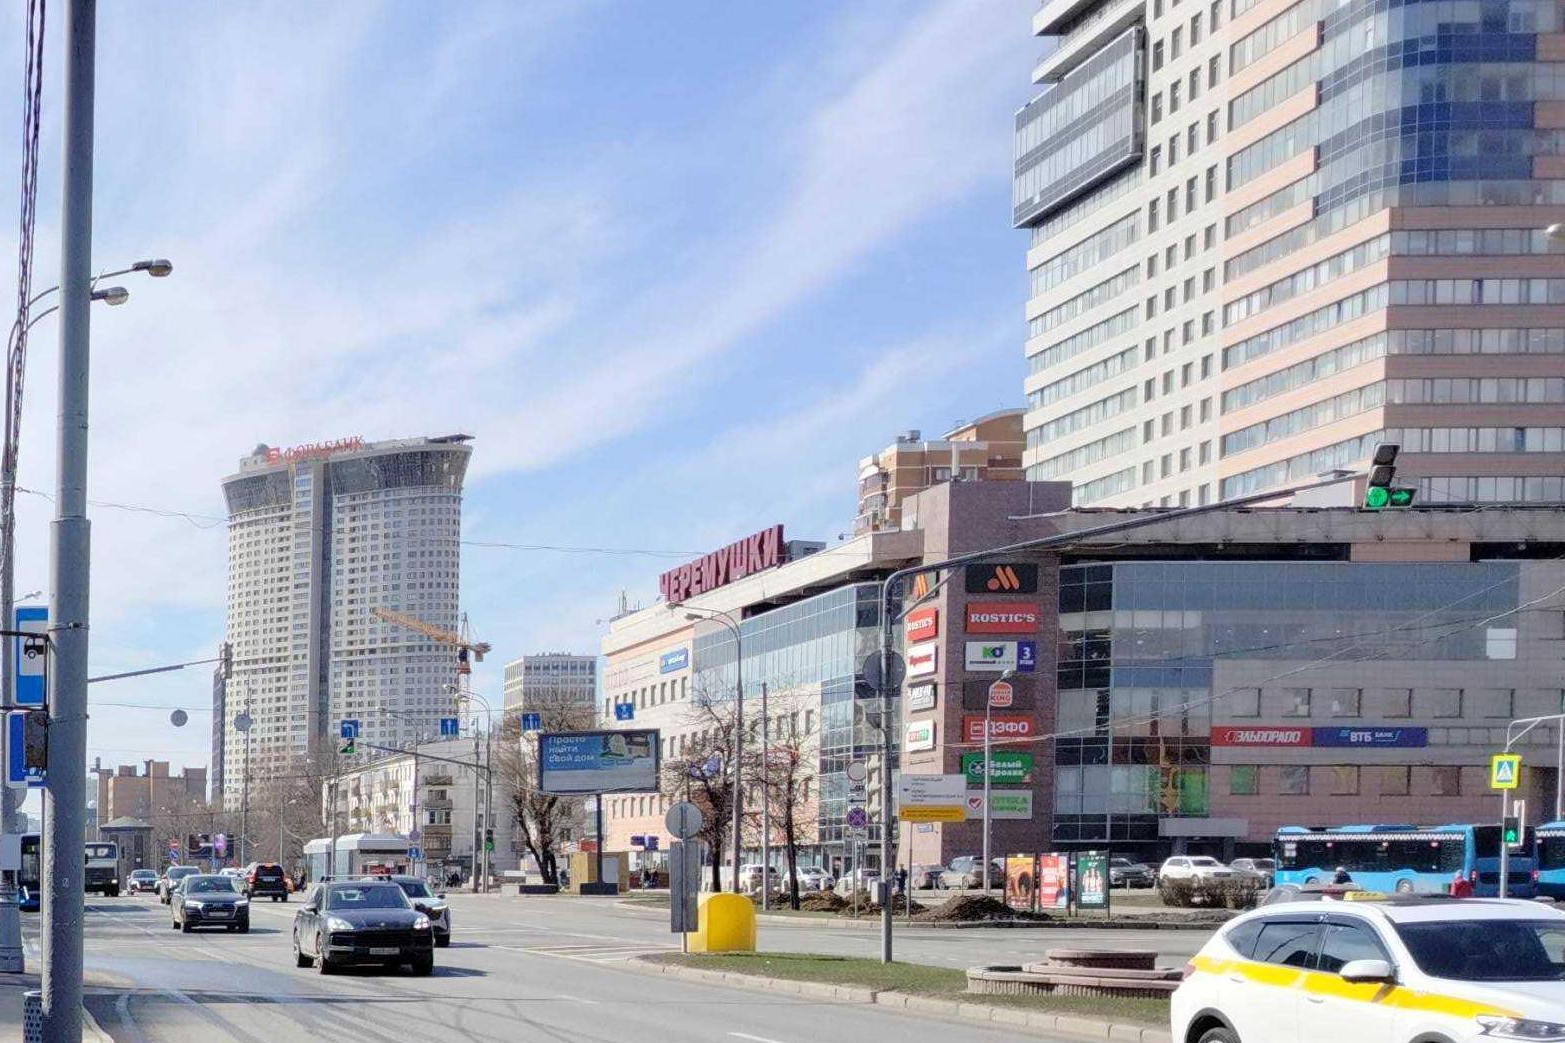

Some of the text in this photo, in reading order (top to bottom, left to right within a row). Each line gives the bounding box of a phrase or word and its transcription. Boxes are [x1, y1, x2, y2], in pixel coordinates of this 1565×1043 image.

[659, 524, 784, 603] ЧЕРЕМУШКИ
[970, 613, 1036, 623] ROSTIC'S
[1022, 646, 1031, 660] 3
[1350, 732, 1372, 742] ВТБ
